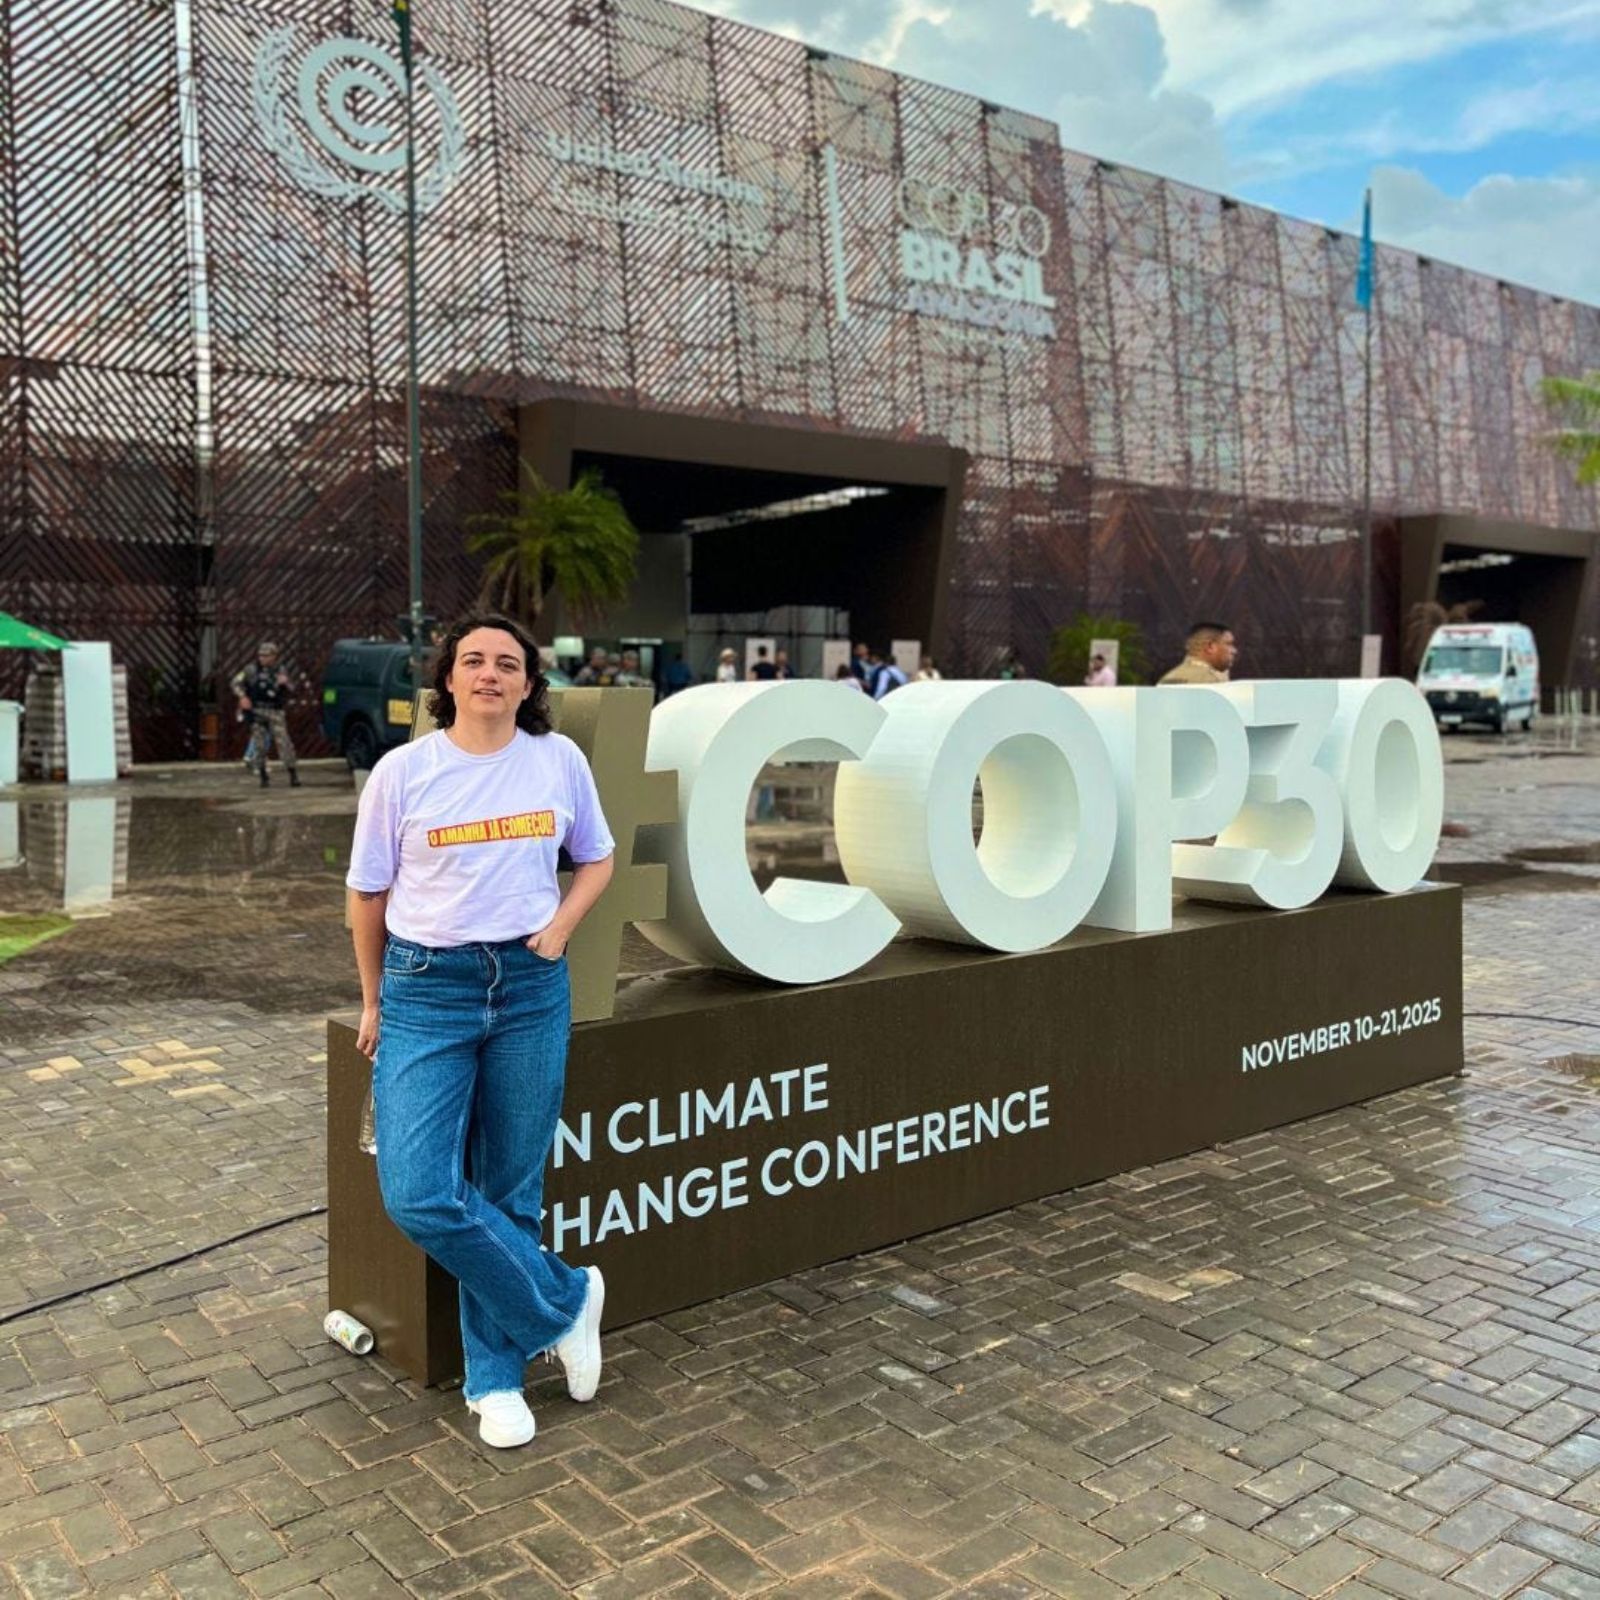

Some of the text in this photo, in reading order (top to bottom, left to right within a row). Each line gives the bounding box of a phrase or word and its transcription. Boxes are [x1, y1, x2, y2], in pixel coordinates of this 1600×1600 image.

[900, 230, 1056, 308] BRASIL
[429, 831, 439, 846] O
[1241, 1021, 1351, 1073] NOVEMBER
[553, 1063, 829, 1169] N CLIMATE
[540, 1084, 1051, 1254] HANGE CONFERENCE
